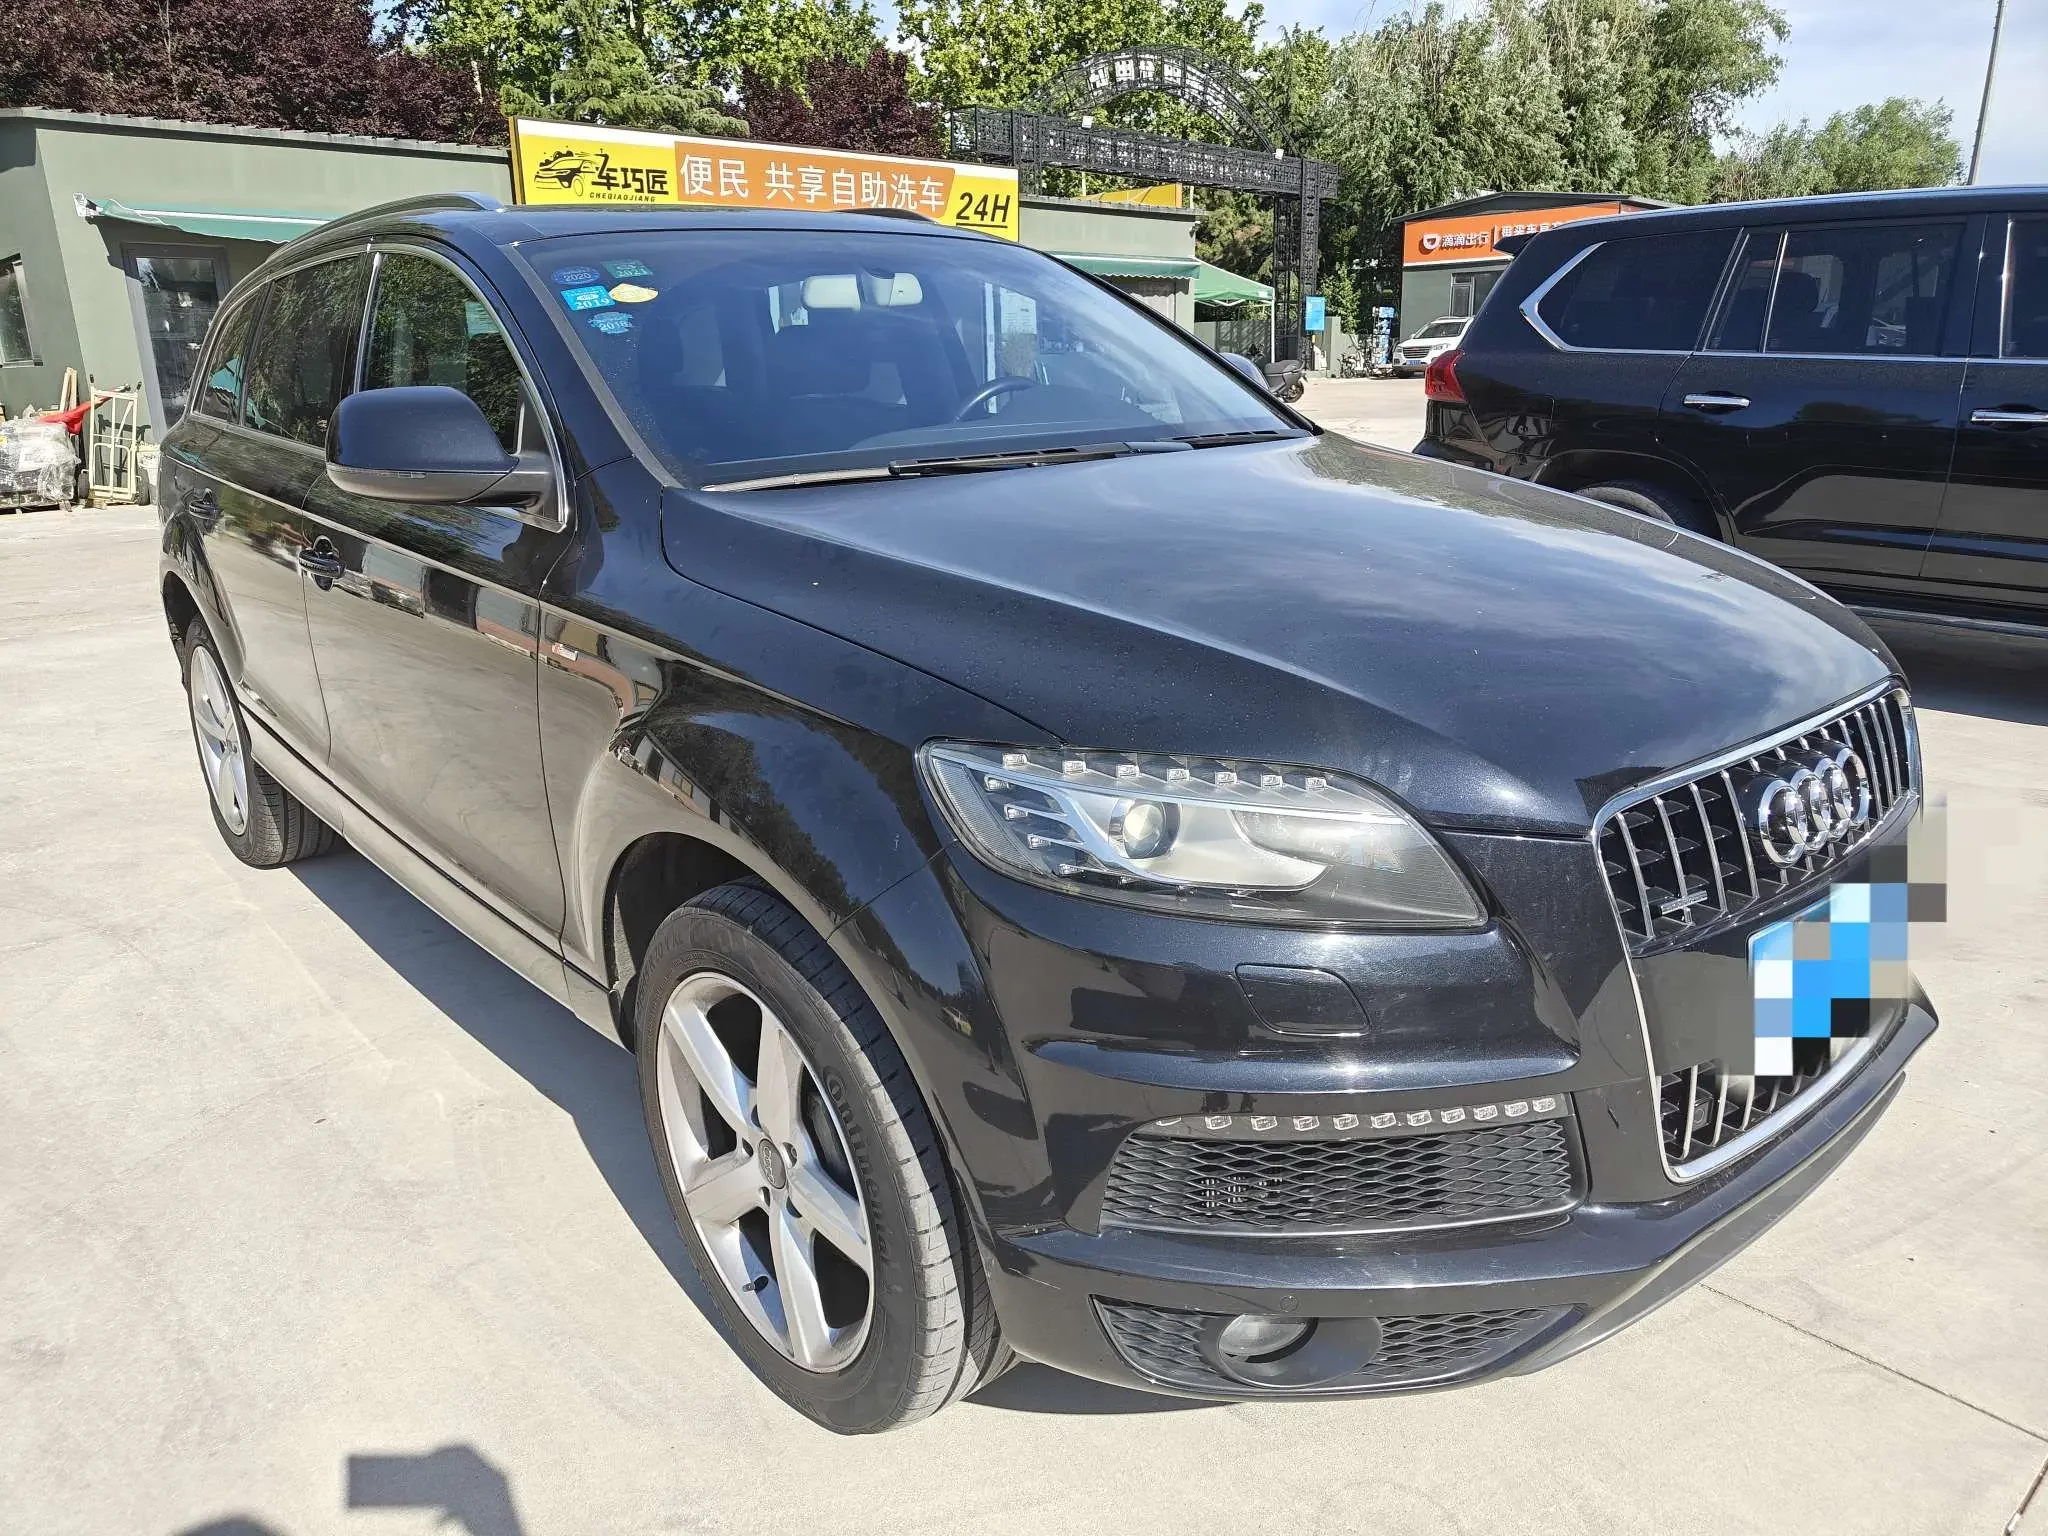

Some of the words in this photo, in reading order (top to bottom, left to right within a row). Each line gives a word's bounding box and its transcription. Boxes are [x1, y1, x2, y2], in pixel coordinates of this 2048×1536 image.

[592, 149, 669, 195] 车巧匠
[680, 153, 749, 198] 便民
[764, 161, 945, 212] 共享自助洗车
[589, 191, 656, 203] CHEQIAOJIANG
[956, 192, 1011, 223] 24H
[1441, 232, 1488, 247] 滴滴出行
[563, 268, 592, 281] 2020
[575, 298, 611, 310] 2019
